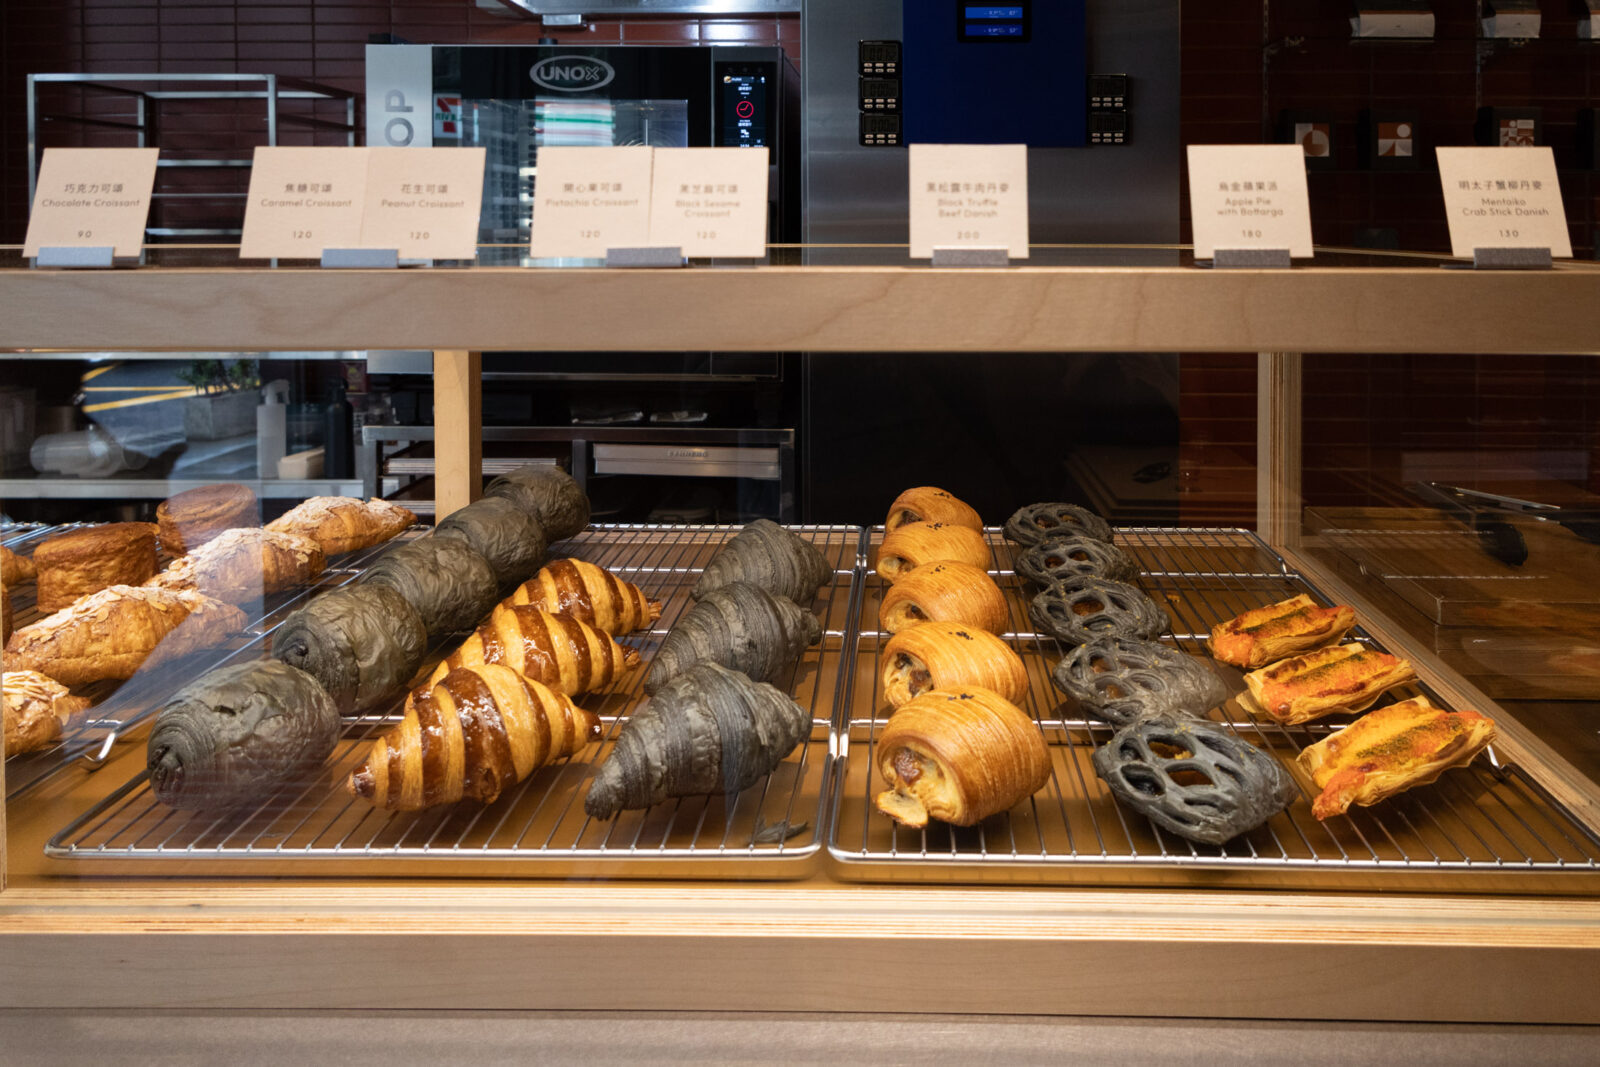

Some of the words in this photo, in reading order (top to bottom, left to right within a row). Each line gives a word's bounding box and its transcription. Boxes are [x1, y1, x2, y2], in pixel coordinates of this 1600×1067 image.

[540, 66, 600, 80] UNOX
[64, 183, 124, 194] 巧克力可頌
[401, 183, 448, 194] 花生可頌
[41, 199, 91, 208] Chocolate
[93, 199, 141, 208] Croissant
[260, 198, 303, 208] Caramel
[305, 198, 353, 208] Croissant
[381, 199, 416, 208] Peanut
[418, 199, 465, 208] Croissant
[545, 198, 590, 208] Pistachio
[592, 198, 639, 208] Croissant
[675, 199, 701, 208] Black
[704, 199, 741, 208] Sesame
[1225, 197, 1254, 207] Apple
[1256, 197, 1272, 206] Pie
[1481, 197, 1527, 207] Mentaiko
[684, 209, 731, 218] Croissant
[938, 209, 962, 218] Beef
[964, 209, 998, 218] Danish
[1217, 207, 1239, 216] with
[1462, 207, 1487, 217] Crab
[1489, 207, 1513, 217] Stick
[1515, 207, 1550, 217] Danish
[77, 230, 92, 239] 90
[292, 230, 313, 239] 120
[410, 231, 430, 240] 120
[580, 230, 601, 239] 120
